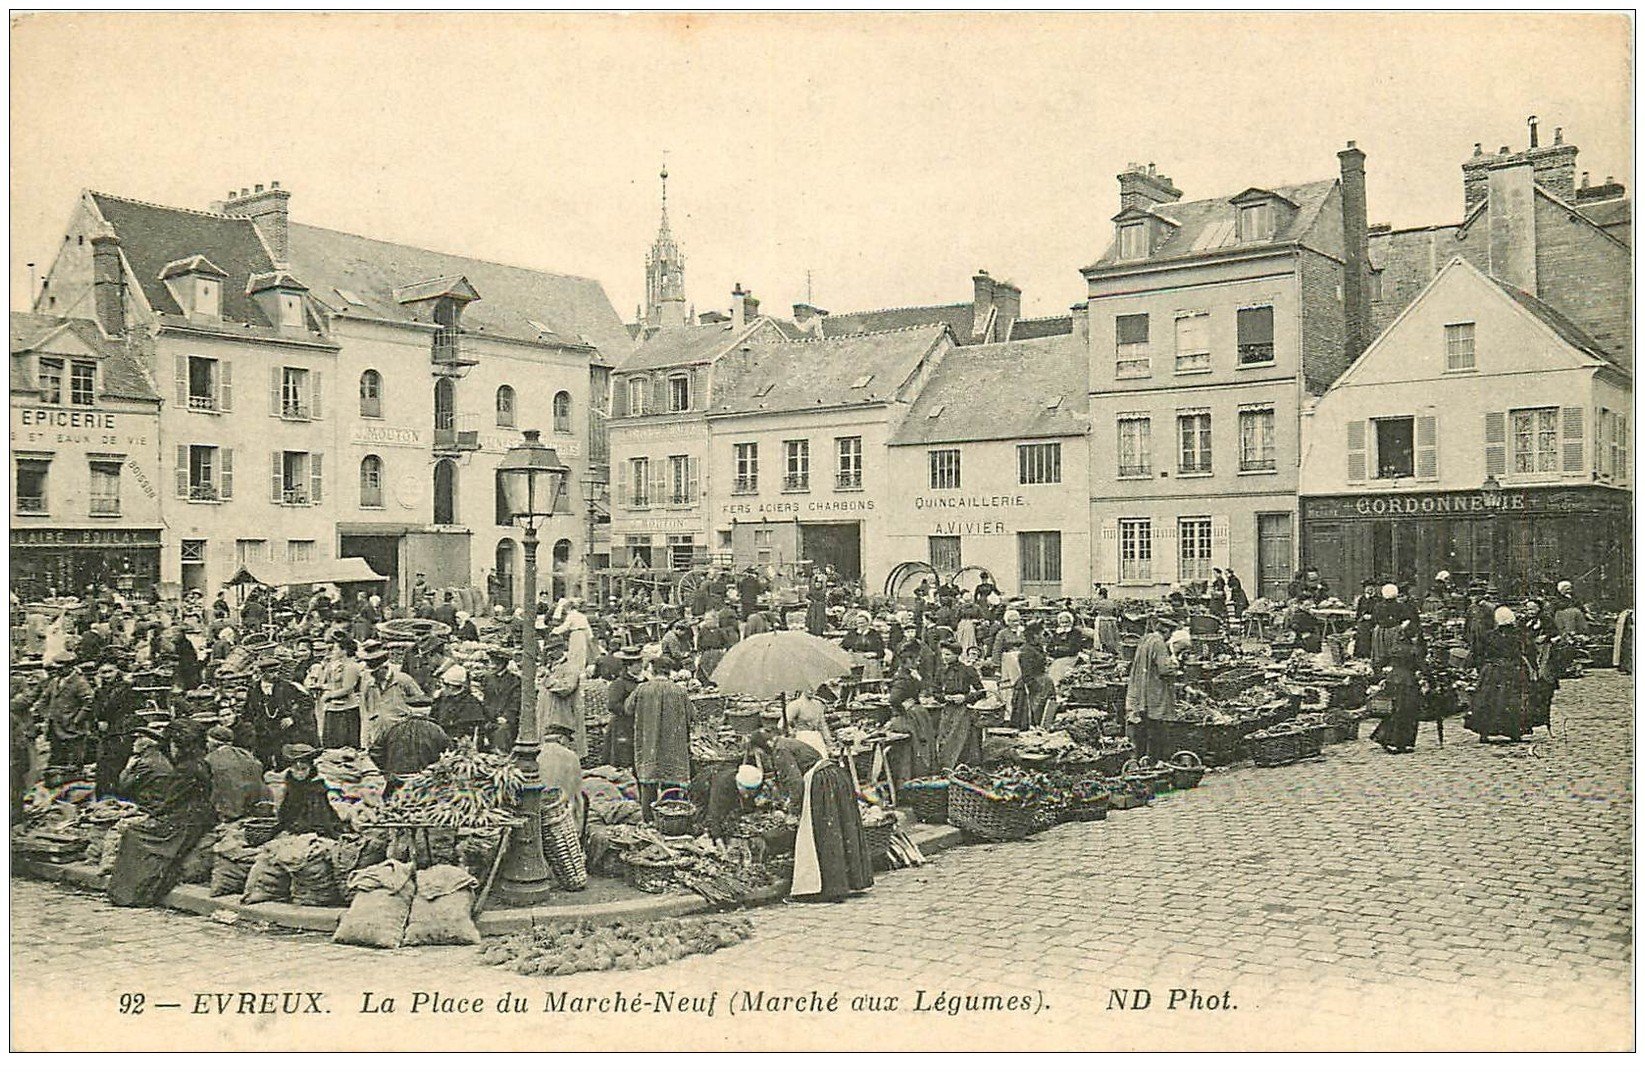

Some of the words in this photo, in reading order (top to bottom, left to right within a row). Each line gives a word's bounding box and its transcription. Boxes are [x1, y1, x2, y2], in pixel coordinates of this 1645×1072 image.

[22, 410, 115, 429] EPICERIE
[29, 432, 43, 442] ET
[57, 433, 90, 444] EAUX
[102, 434, 117, 445] DE
[128, 436, 147, 446] VIE
[723, 503, 751, 514] FERS
[759, 502, 799, 513] ACIERS
[809, 500, 875, 511] CHARBONS
